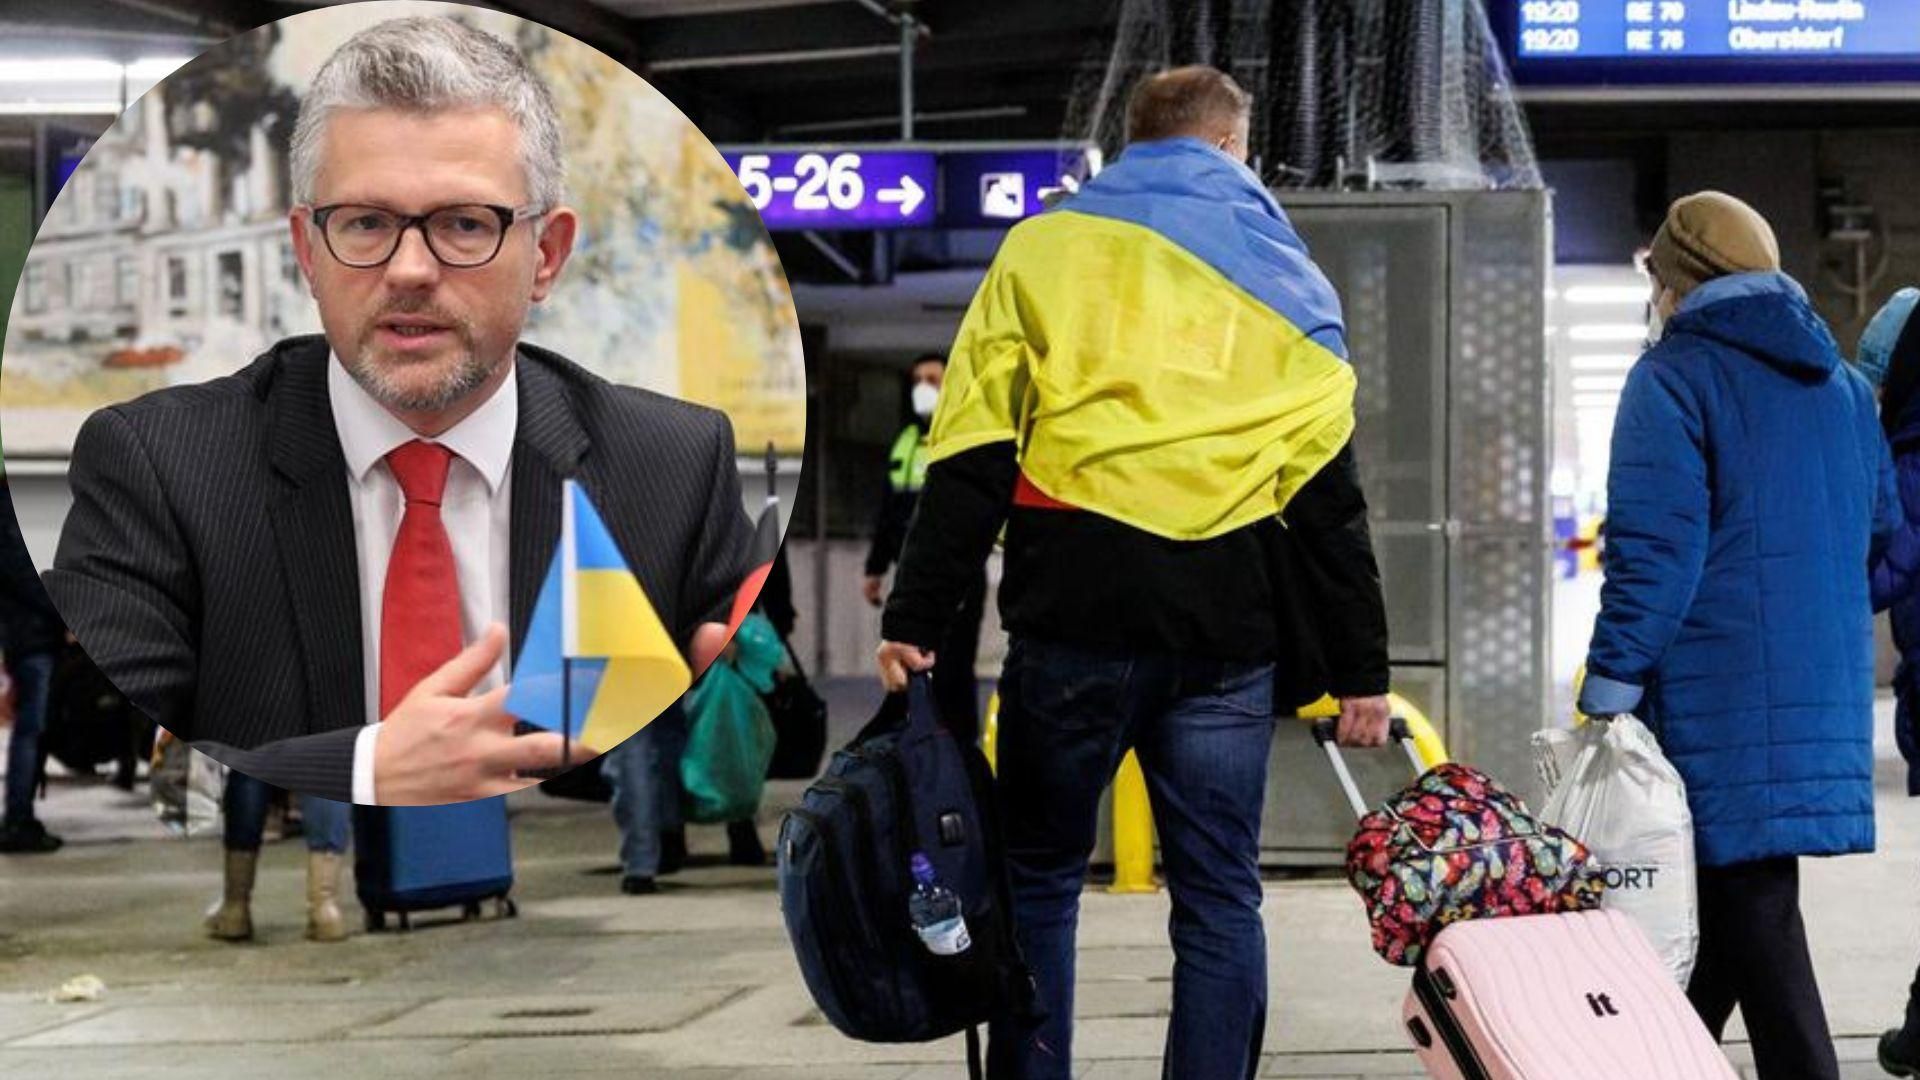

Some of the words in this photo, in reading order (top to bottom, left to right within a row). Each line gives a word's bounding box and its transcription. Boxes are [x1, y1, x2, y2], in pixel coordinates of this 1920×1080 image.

[1626, 1, 1653, 21] RE
[1626, 29, 1653, 50] RE
[1728, 27, 1844, 50] Oberstdorf
[1585, 992, 1619, 1017] it
